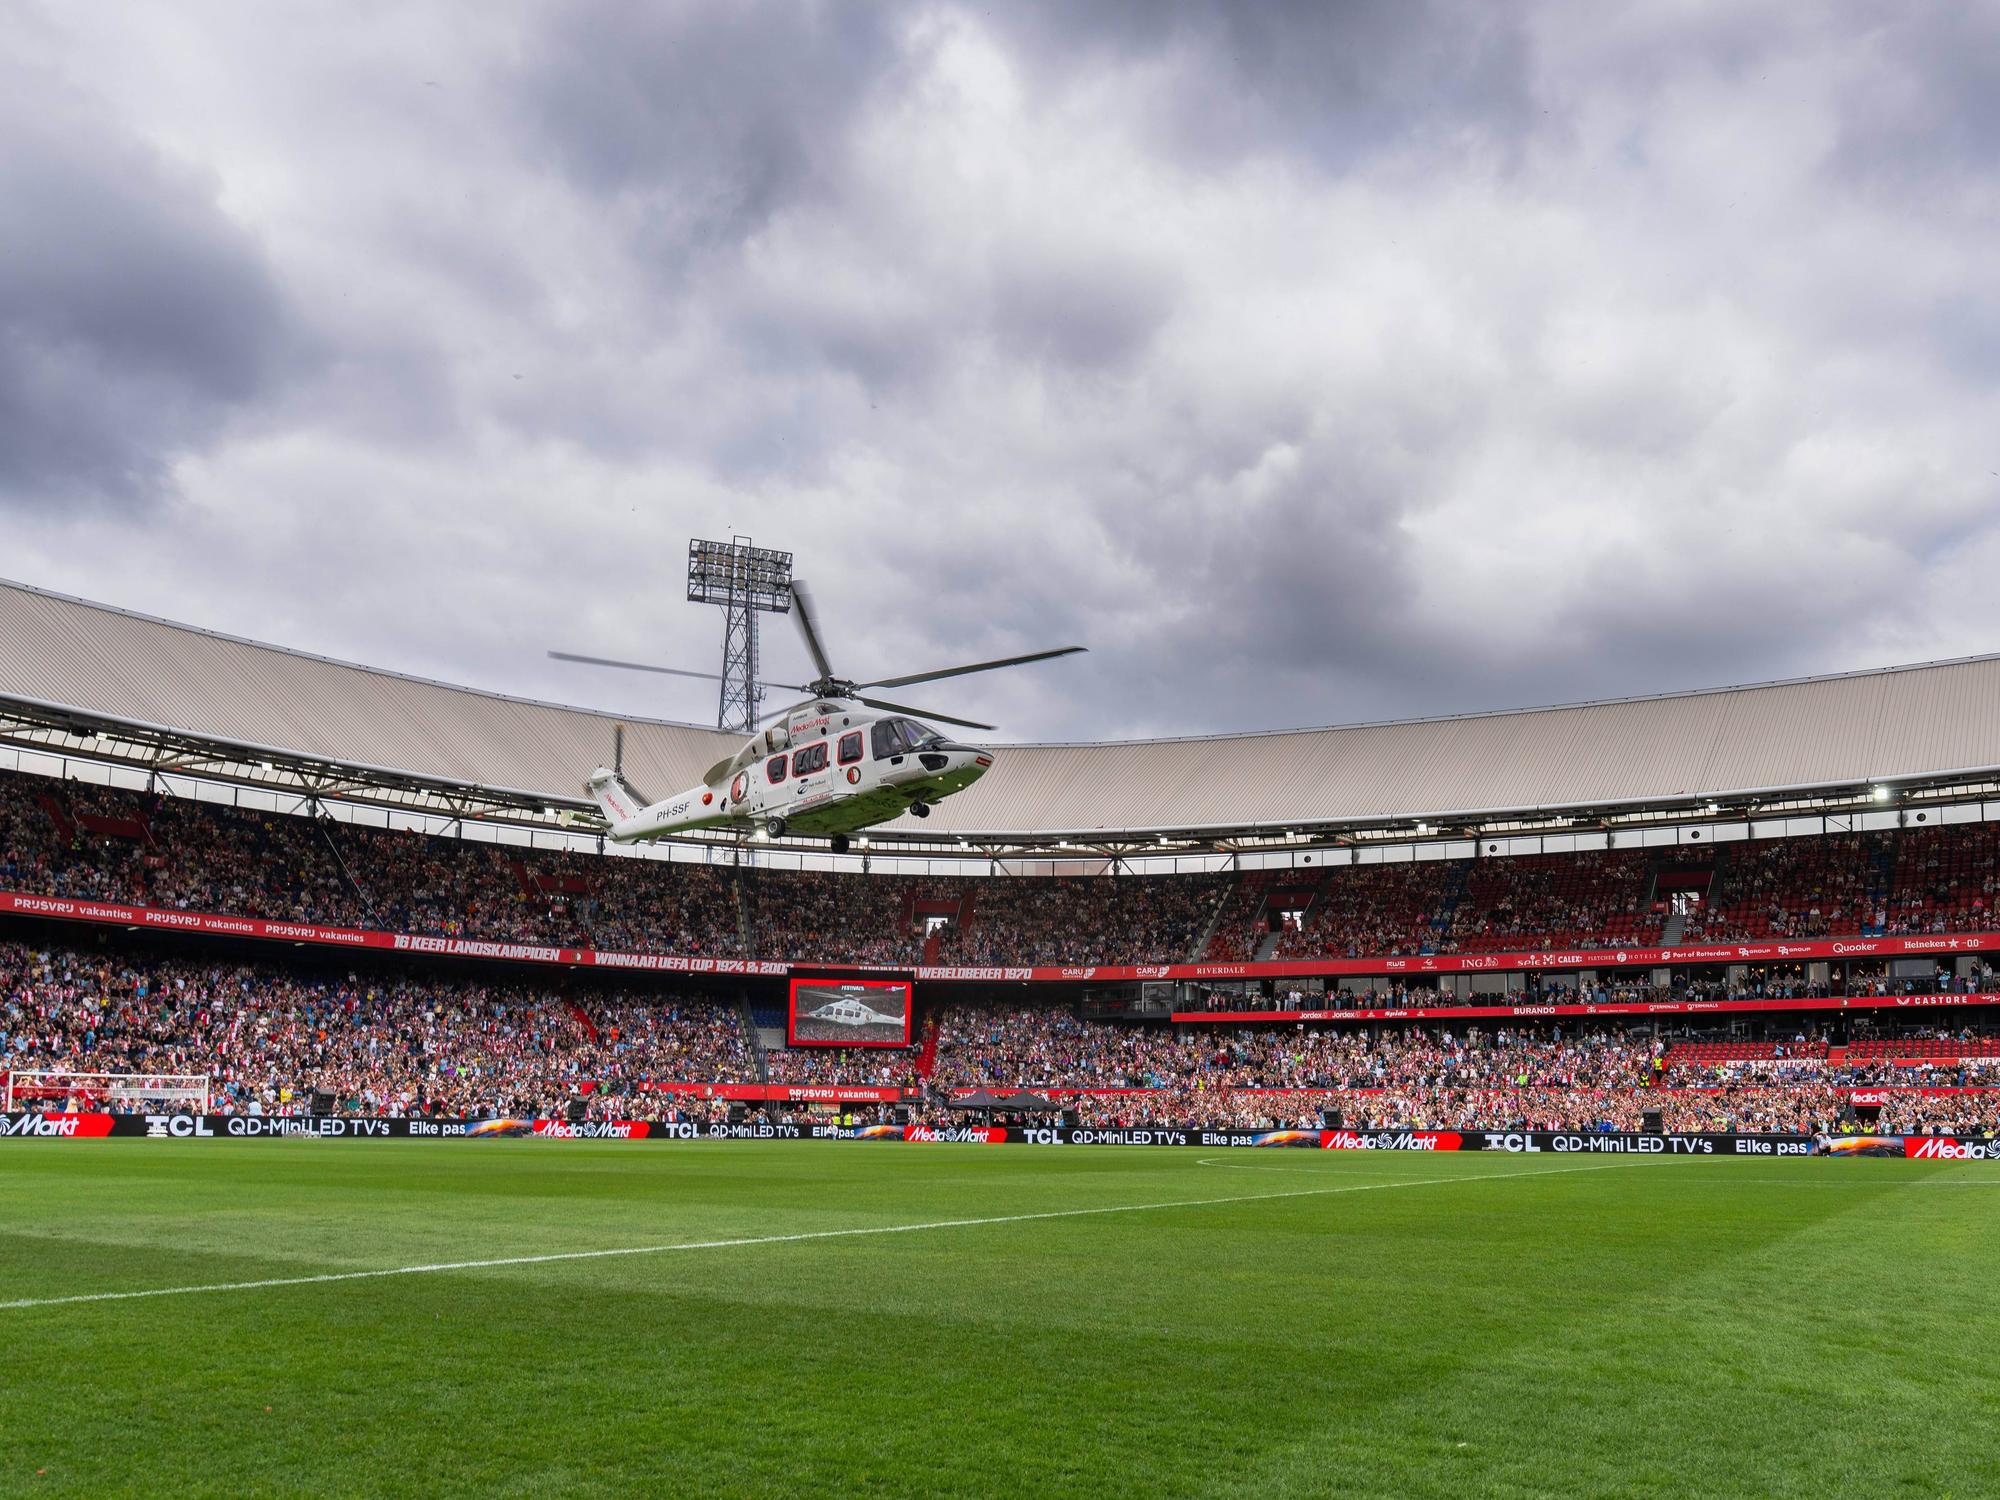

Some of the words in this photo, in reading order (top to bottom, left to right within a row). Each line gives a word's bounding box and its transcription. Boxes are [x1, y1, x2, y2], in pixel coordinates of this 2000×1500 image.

[656, 801, 690, 821] PH-SSF
[79, 906, 132, 919] vakanties
[205, 919, 253, 931] vakanties
[319, 931, 364, 942] vakanties
[394, 935, 410, 948] 16
[410, 936, 446, 951] KEER
[447, 940, 560, 960] LANDSKAMPIOEN
[1832, 943, 1877, 953] Quooker
[1904, 940, 1946, 949] Heineken
[595, 952, 656, 967] WINNAAR
[657, 957, 689, 970] UEFA
[690, 959, 714, 971] CUP
[715, 960, 744, 972] 1974
[1461, 959, 1483, 967] ING
[919, 967, 1001, 979] WERELDBEKER
[1004, 968, 1032, 979] 1970
[1197, 966, 1245, 975] RIVERDALE
[1914, 996, 1967, 1005] CASTORE
[1514, 1007, 1555, 1015] BURANDO
[838, 1091, 879, 1099] vakanties
[146, 1116, 213, 1136] TCL
[409, 1122, 440, 1134] Elke
[442, 1124, 466, 1136] pas
[665, 1122, 700, 1138] TCL
[838, 1128, 855, 1139] pas
[1023, 1129, 1064, 1144] TCL
[1202, 1132, 1229, 1145] Elke
[1231, 1136, 1252, 1148] pas
[1485, 1134, 1541, 1152] TCL
[1735, 1139, 1771, 1153] Elke
[1777, 1142, 1807, 1155] pas
[1913, 1139, 1986, 1159] Media
